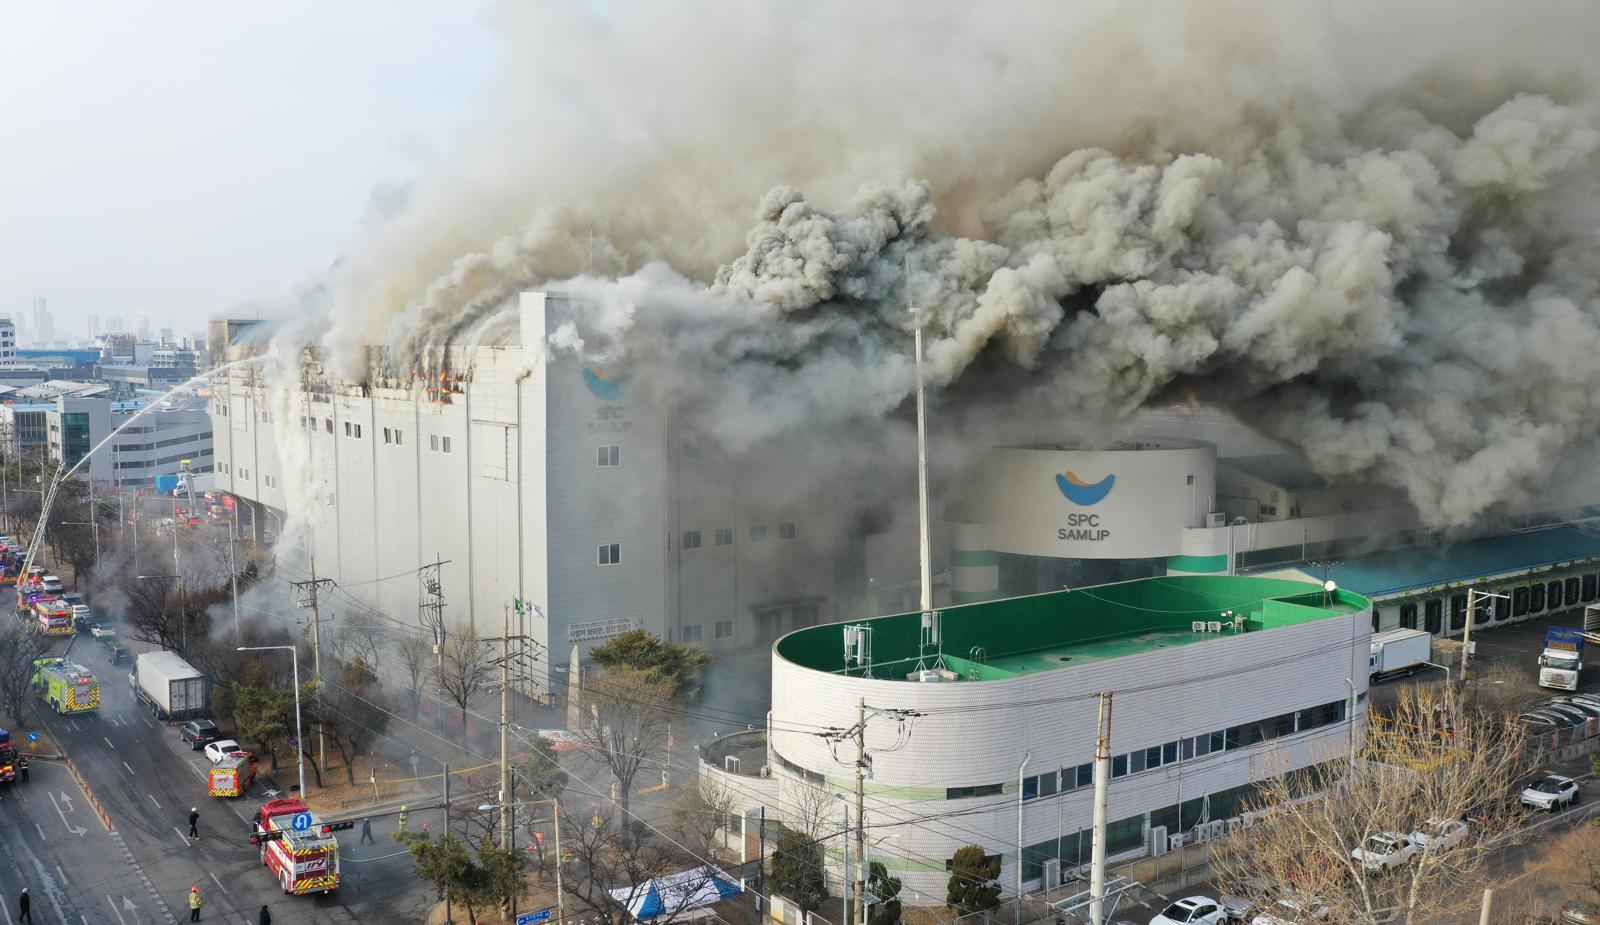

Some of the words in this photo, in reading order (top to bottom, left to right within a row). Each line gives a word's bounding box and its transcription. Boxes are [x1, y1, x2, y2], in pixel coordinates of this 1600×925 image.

[598, 405, 623, 419] SPC
[1068, 513, 1099, 527] SPC
[1058, 528, 1110, 541] SAMLIP
[306, 857, 326, 869] 119
